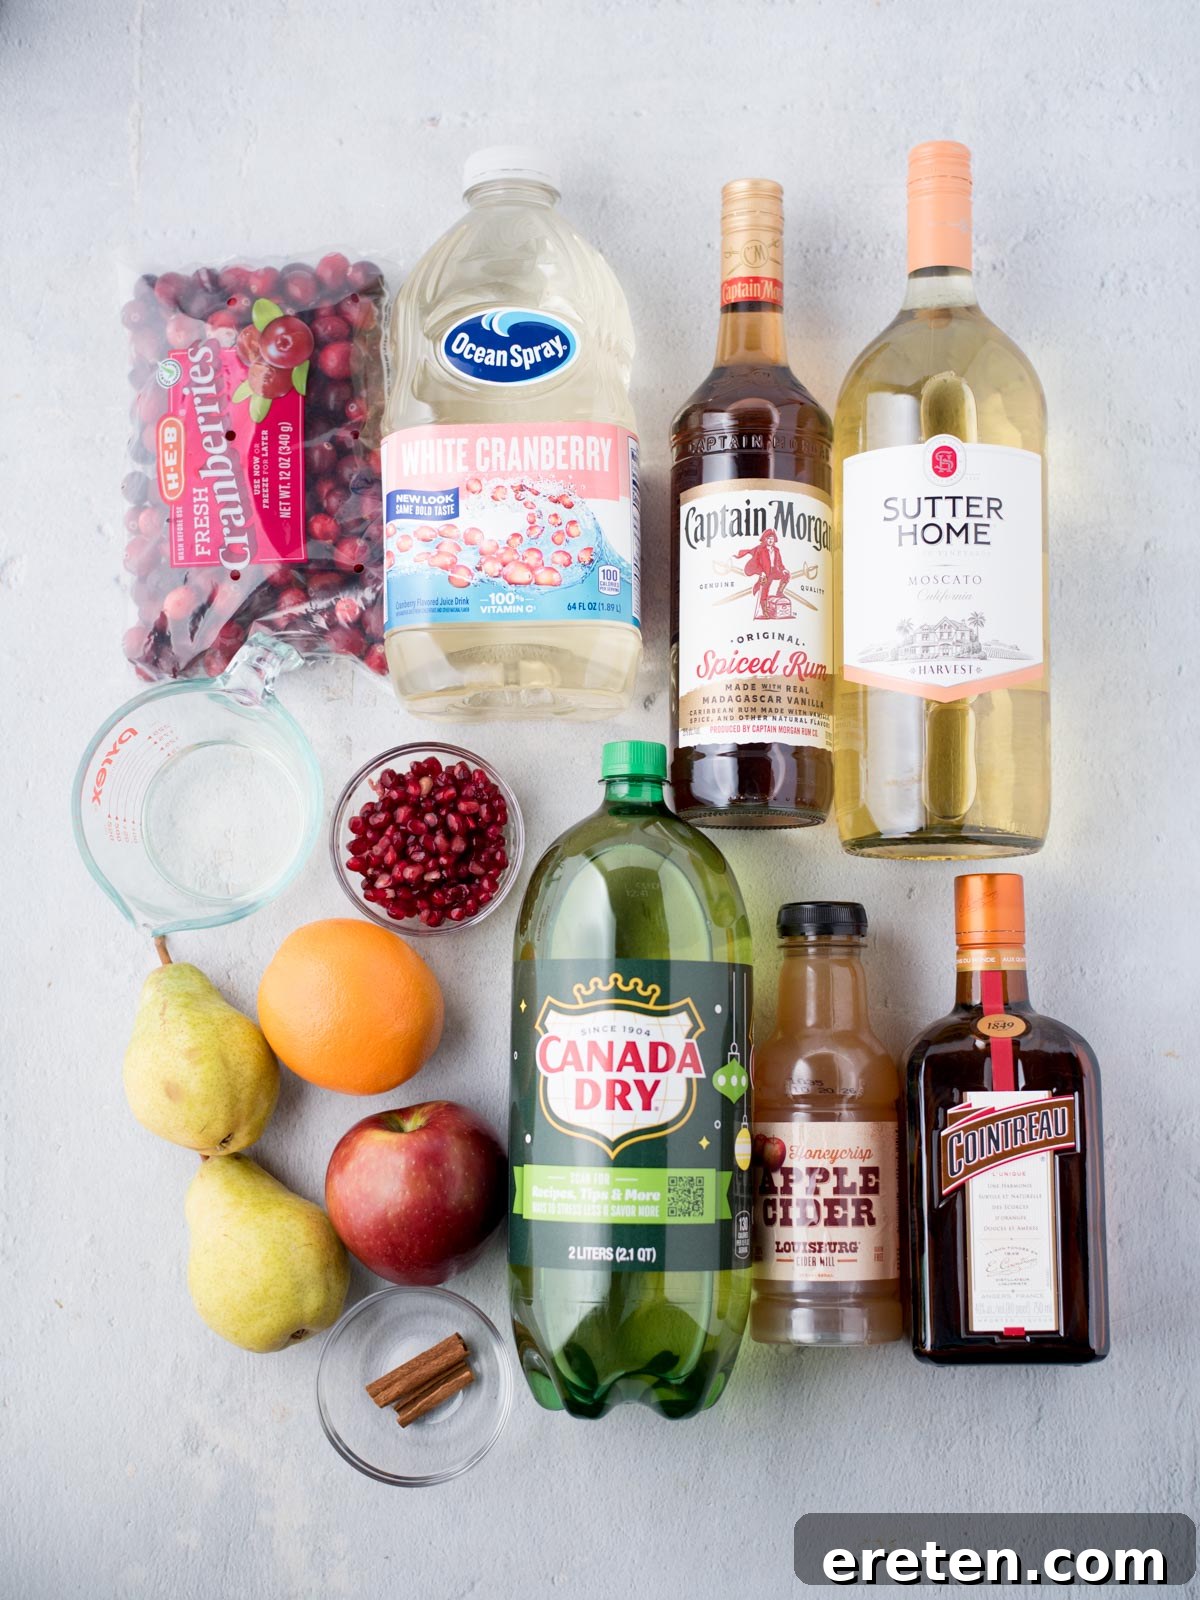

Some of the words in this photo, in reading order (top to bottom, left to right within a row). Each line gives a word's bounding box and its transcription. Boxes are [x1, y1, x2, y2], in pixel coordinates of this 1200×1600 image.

[722, 279, 760, 304] Captain
[451, 332, 508, 367] Ocean
[510, 335, 564, 370] Spray
[277, 422, 293, 432] g)
[261, 429, 269, 457] LATER
[278, 434, 292, 455] (340
[689, 434, 763, 453] CAPTAIN
[164, 427, 179, 490] H-E-B
[182, 345, 251, 571] Cranberries
[278, 457, 291, 468] OZ
[402, 438, 469, 477] WHITE
[475, 436, 612, 473] CRANBERRY
[279, 470, 291, 481] 12
[253, 479, 261, 495] USE
[262, 477, 270, 509] FREEZE
[279, 482, 291, 500] WT.
[396, 493, 421, 504] NEW
[422, 493, 455, 504] LOOK
[279, 501, 291, 518] NET
[395, 504, 414, 514] SAME
[415, 505, 432, 516] BOLD
[434, 503, 455, 516] TASTE
[883, 495, 1004, 521] SUTTER
[193, 487, 211, 556] FRESH
[685, 499, 767, 549] Captain
[897, 522, 991, 547] HOME
[601, 569, 618, 581] 100
[908, 575, 982, 586] MOSCATO
[699, 581, 735, 590] GENUINE
[800, 584, 825, 595] QUALITY
[440, 597, 453, 606] Juice
[455, 596, 470, 605] Drink
[488, 592, 525, 605] 100%
[480, 605, 524, 614] VITAMIN
[567, 602, 577, 611] 64
[579, 602, 588, 611] FL
[589, 602, 597, 611] OZ
[598, 602, 615, 612] (1.89
[737, 632, 800, 646] ORIGINAL
[696, 650, 781, 680] Spiced
[783, 650, 827, 681] Rum
[918, 665, 973, 675] HARVEST
[725, 683, 756, 691] MADE
[761, 683, 782, 691] WITH
[786, 685, 809, 695] REAL
[702, 694, 782, 704] MADAGASCAR
[787, 696, 824, 709] VANILLA
[689, 707, 734, 716] CARIBBEAN
[761, 706, 784, 714] MADE
[788, 708, 807, 716] WITH
[738, 714, 768, 722] OTHER
[772, 715, 811, 725] NATURAL
[742, 725, 750, 733] BY
[752, 725, 777, 733] CAPTAIN
[778, 726, 800, 735] MORGAN
[580, 1025, 617, 1036] SINCE
[622, 1026, 651, 1036] 1904
[987, 1021, 1015, 1030] 1849
[538, 1035, 703, 1074] CANADA
[574, 1078, 661, 1112] DRY
[947, 1107, 1067, 1178] COINTREAU
[789, 1145, 873, 1164] Honeycrisp
[759, 1166, 880, 1195] APPLE
[580, 1187, 609, 1202] Tips
[611, 1188, 622, 1201] &
[624, 1188, 661, 1201] More
[610, 1205, 636, 1217] SAVOR
[638, 1205, 660, 1217] MORE
[762, 1198, 876, 1227] CIDER
[568, 1247, 577, 1259] 2
[577, 1247, 613, 1261] LITERS
[615, 1247, 635, 1262] (2.1
[637, 1247, 657, 1263] QT)
[775, 1241, 859, 1254] LOUISBURG
[796, 1256, 817, 1266] CIDER
[819, 1256, 836, 1267] MILL
